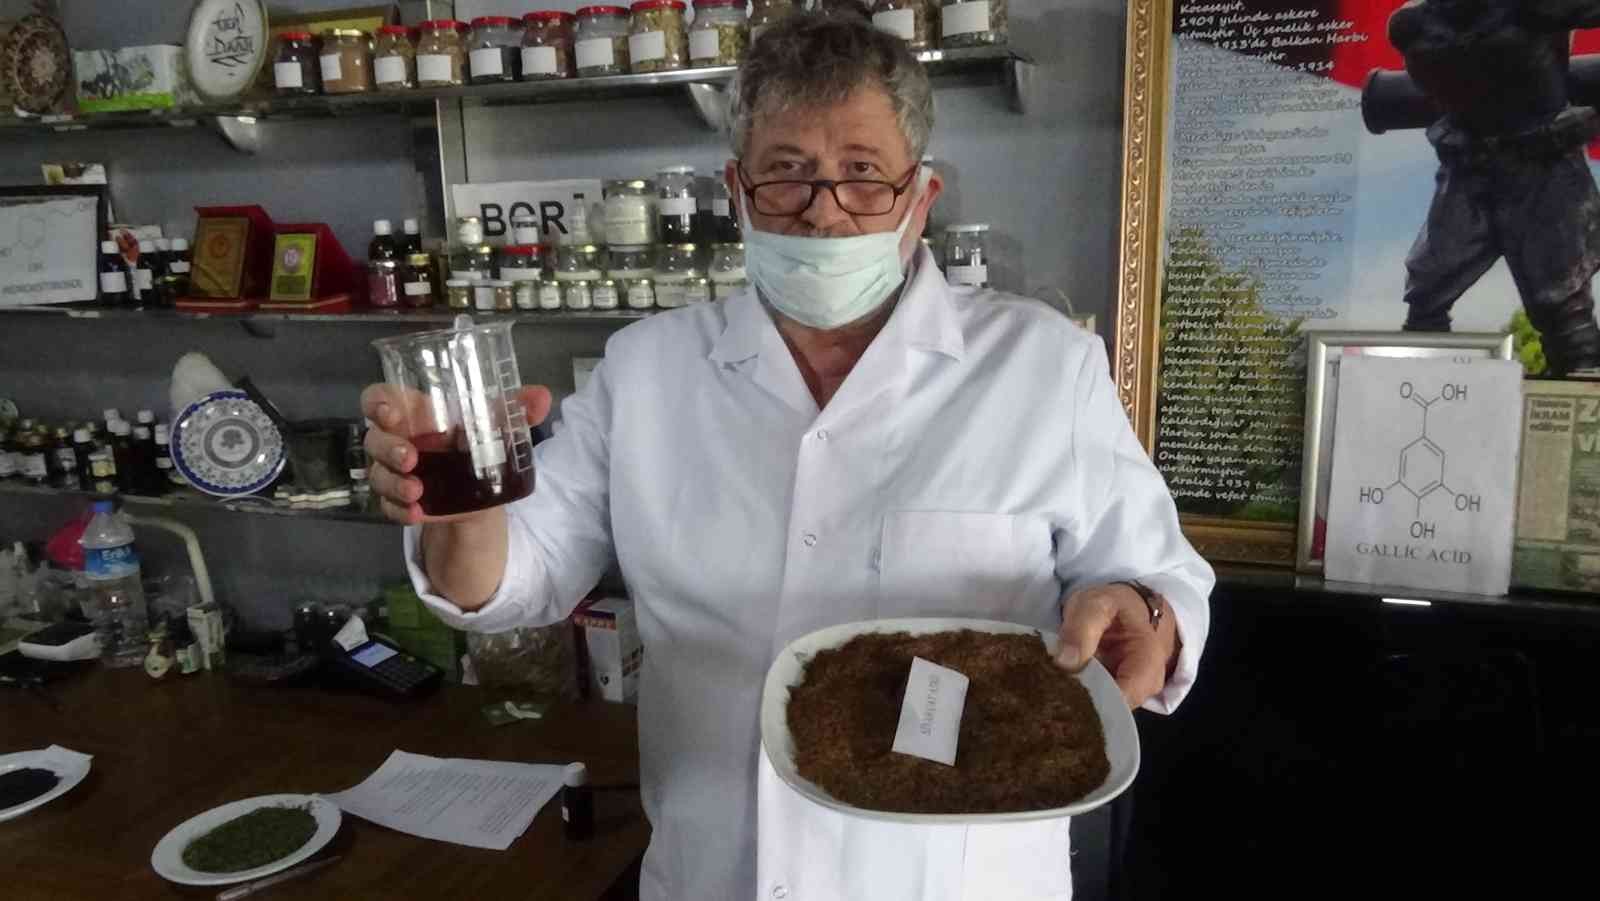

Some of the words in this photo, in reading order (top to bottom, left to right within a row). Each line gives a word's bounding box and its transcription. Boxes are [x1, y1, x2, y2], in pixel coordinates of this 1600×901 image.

[1274, 9, 1319, 21] askere
[1316, 19, 1355, 31] asker
[1271, 35, 1323, 48] Balkan
[1325, 32, 1369, 44] Harbi
[1400, 381, 1413, 399] O
[1441, 383, 1467, 401] OH
[1360, 486, 1383, 504] HO
[1455, 493, 1481, 512] OH
[1410, 520, 1435, 539] OH
